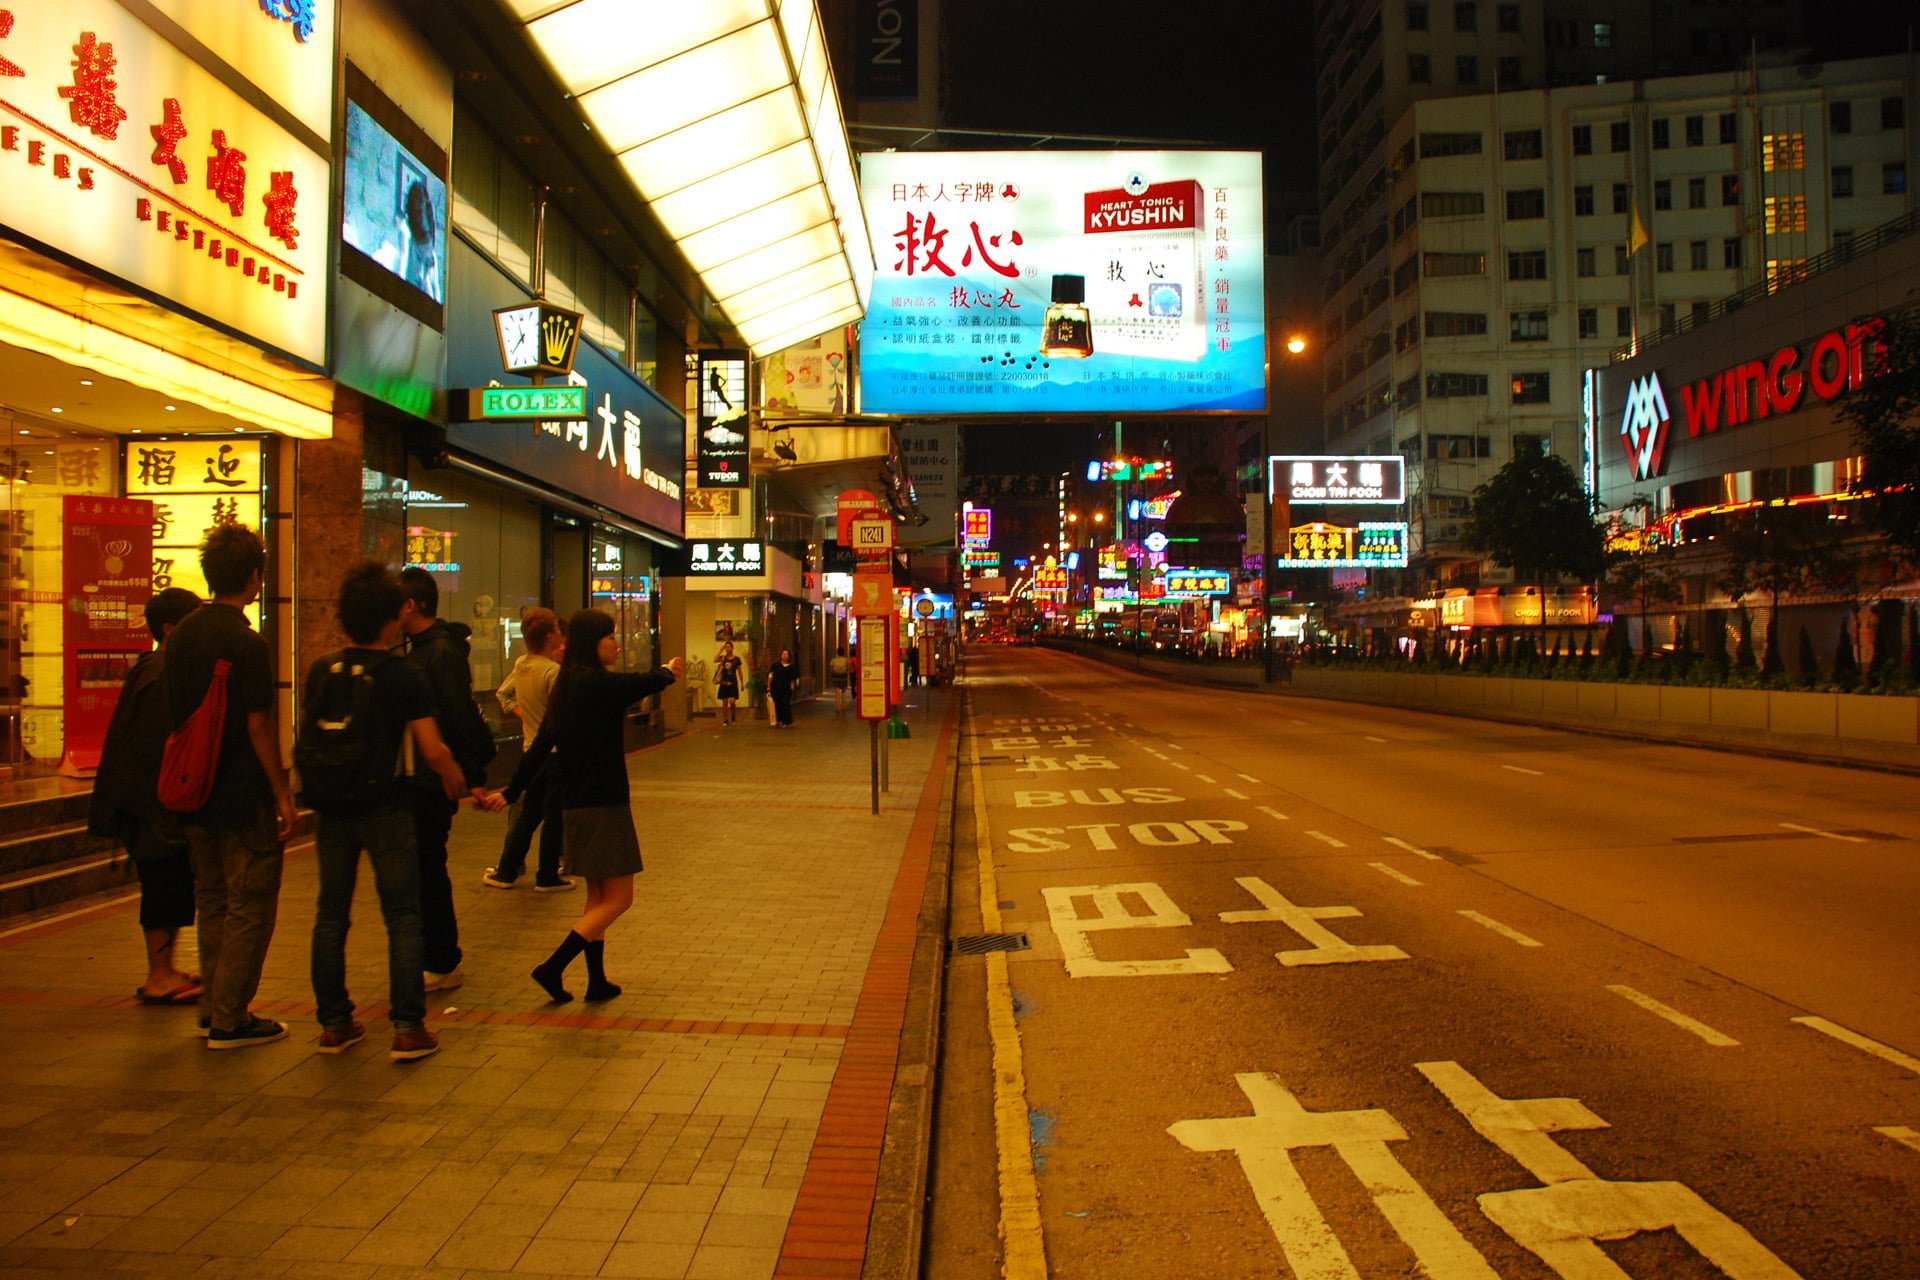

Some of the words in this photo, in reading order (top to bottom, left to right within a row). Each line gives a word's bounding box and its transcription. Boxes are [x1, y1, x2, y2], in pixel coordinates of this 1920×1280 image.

[891, 181, 995, 203] 日本人字牌
[1100, 200, 1134, 212] HEART
[1139, 196, 1174, 208] TONIC
[1090, 204, 1185, 229] KYUSHIN
[136, 198, 299, 299] RESTAURANT
[892, 210, 1024, 278] 救心
[948, 286, 1022, 309] 救心丸
[487, 392, 579, 412] ROLEX
[708, 471, 740, 482] TUDOR
[1291, 462, 1383, 487] 周大福
[1291, 486, 1327, 499] CHOW
[1328, 486, 1348, 498] TAI
[1349, 486, 1383, 499] FOOK
[861, 527, 883, 543] N241
[691, 542, 761, 562] 周大福
[871, 547, 887, 555] STOP
[691, 562, 718, 571] CHOW
[718, 562, 734, 571] TAI
[735, 562, 761, 571] FOOK
[1514, 608, 1540, 617] CHOW
[1557, 608, 1582, 617] FOOK
[989, 735, 1094, 751] 巴士
[1013, 786, 1187, 808] BUS
[1006, 819, 1249, 854] STOP
[1041, 876, 1411, 979] 巴士
